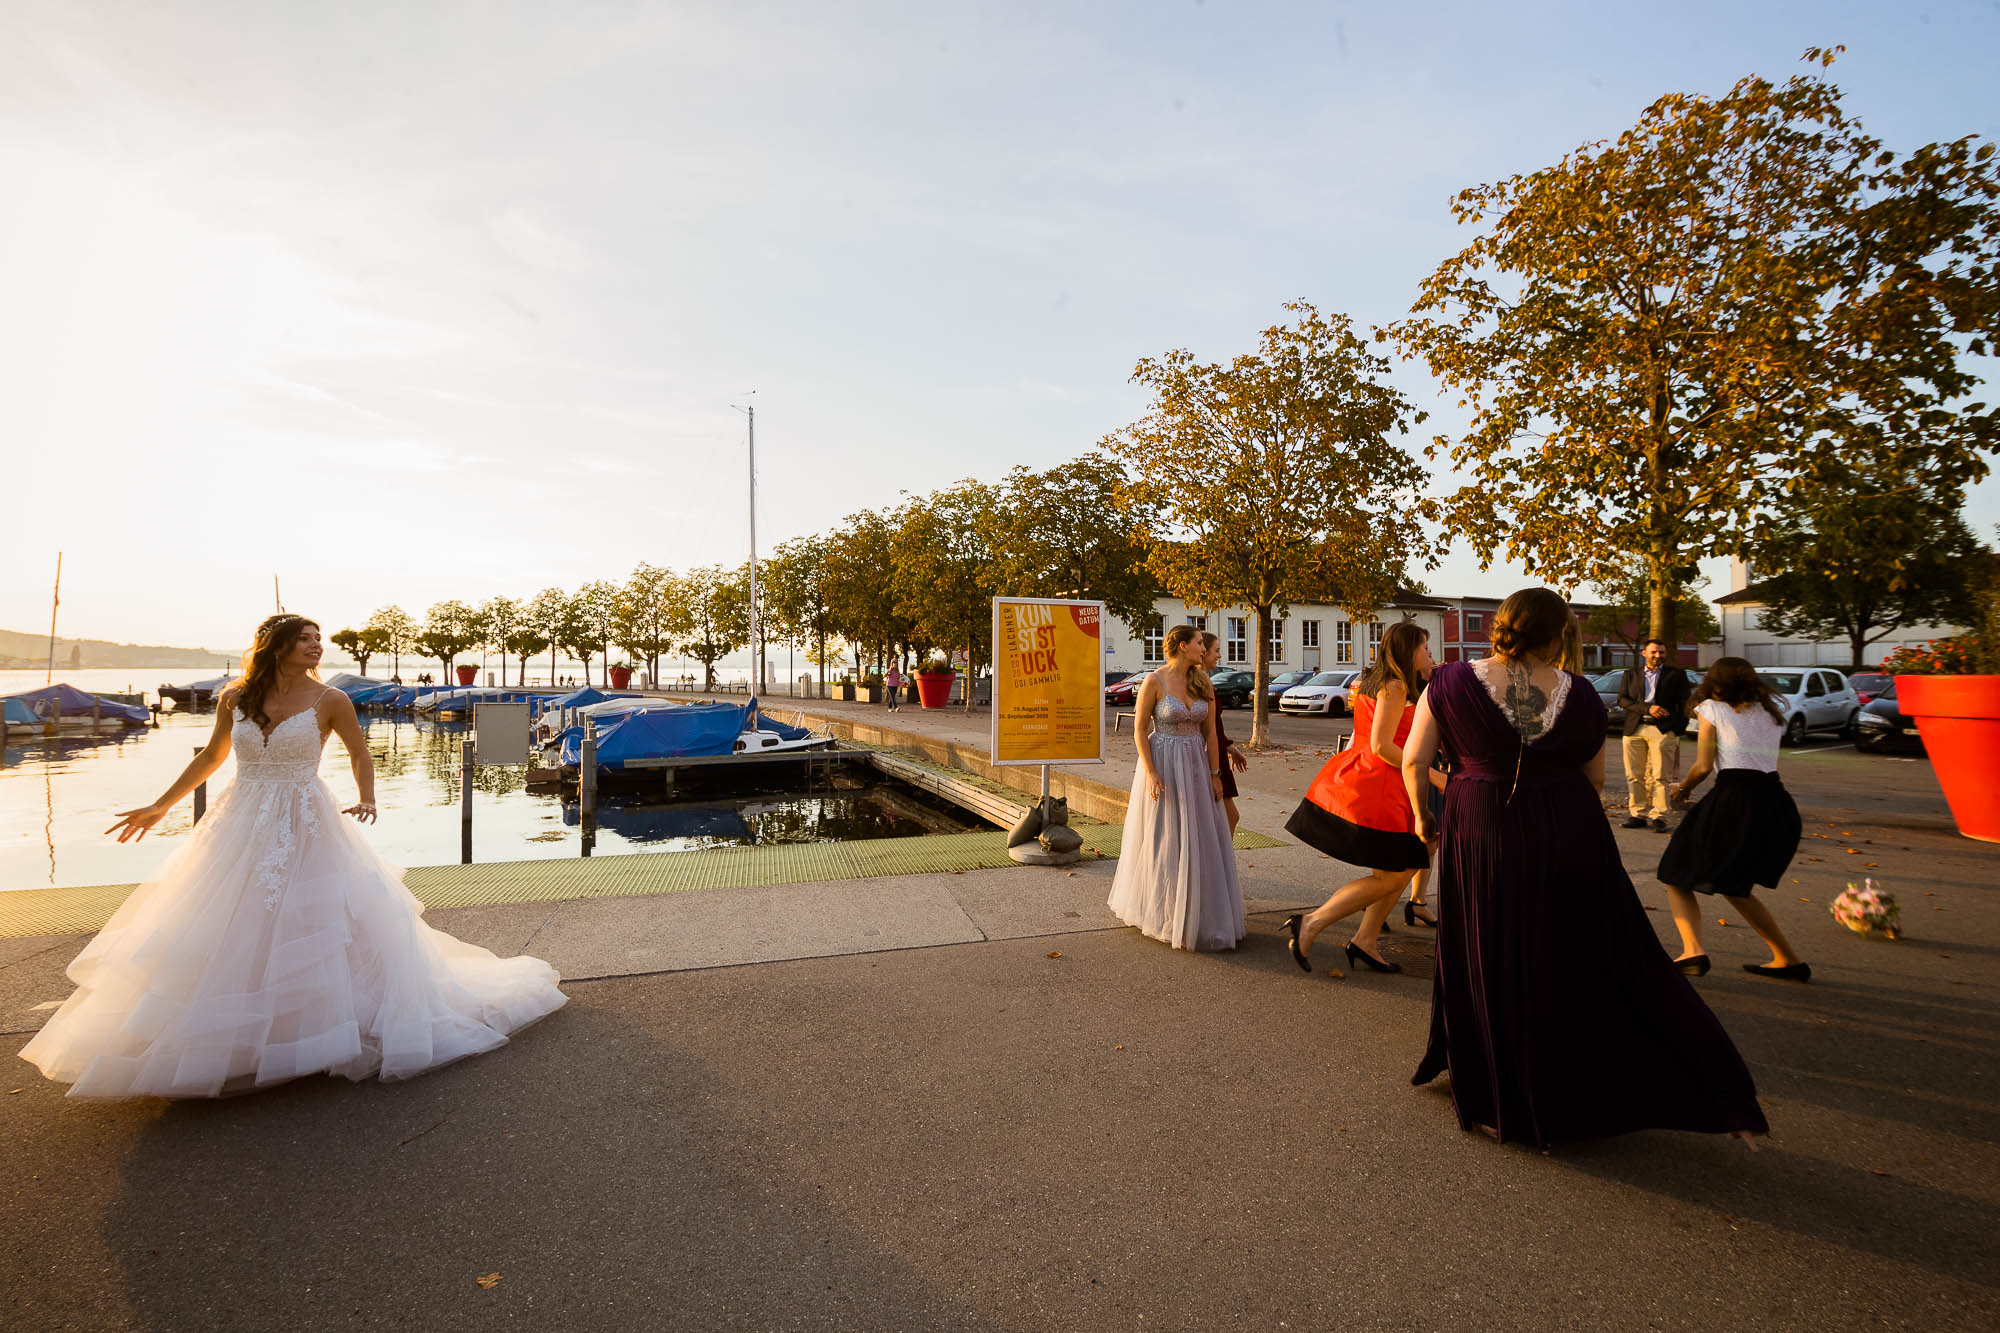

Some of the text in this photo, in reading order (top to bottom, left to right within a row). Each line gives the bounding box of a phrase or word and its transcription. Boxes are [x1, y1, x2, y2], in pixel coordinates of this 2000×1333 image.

[1015, 605, 1053, 628] KUN
[1079, 607, 1098, 616] NEUES
[1004, 608, 1017, 651] LACHNER
